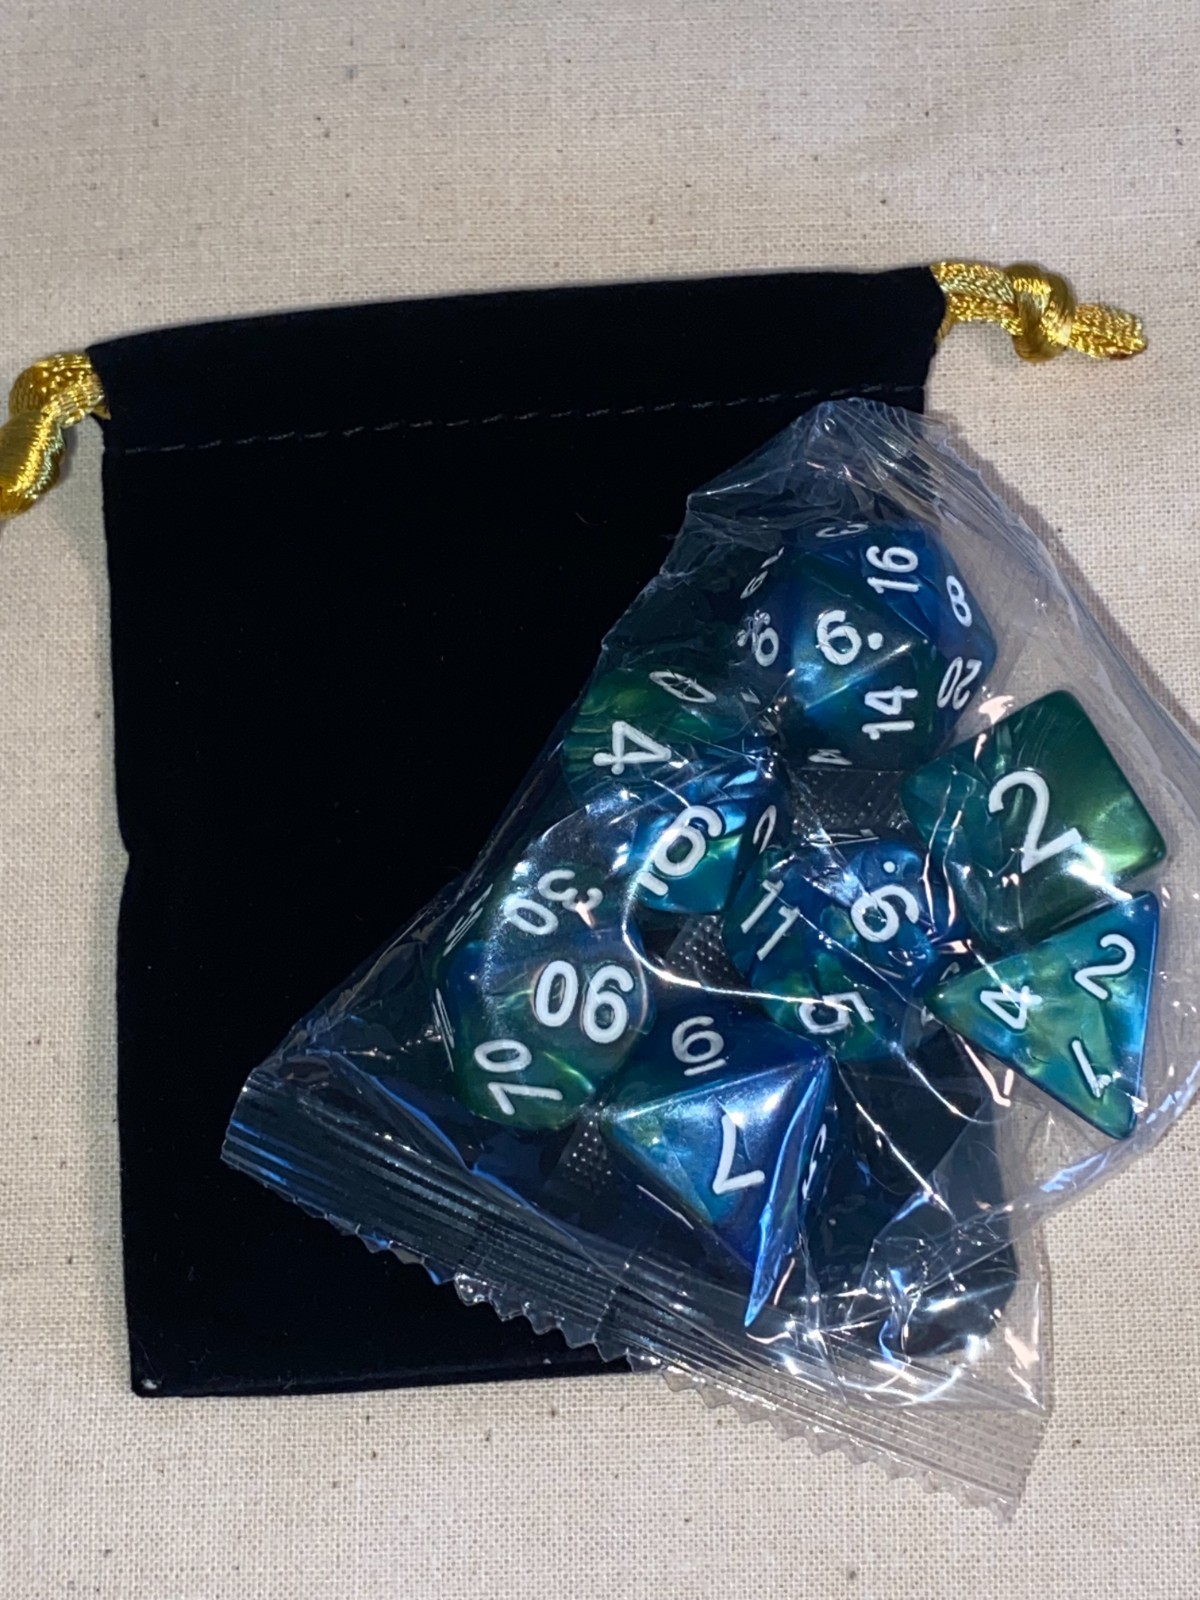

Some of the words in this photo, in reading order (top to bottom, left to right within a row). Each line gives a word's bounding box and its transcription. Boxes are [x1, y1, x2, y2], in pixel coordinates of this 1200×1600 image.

[866, 545, 919, 593] 16
[946, 575, 972, 628] 8
[936, 656, 982, 710] 20
[861, 685, 918, 740] 14
[593, 720, 672, 776] 4
[988, 770, 1083, 874] 2
[740, 879, 800, 961] 11
[1074, 933, 1136, 1000] 2
[799, 991, 876, 1034] 5
[980, 985, 1043, 1030] 4
[712, 1113, 766, 1195] 7
